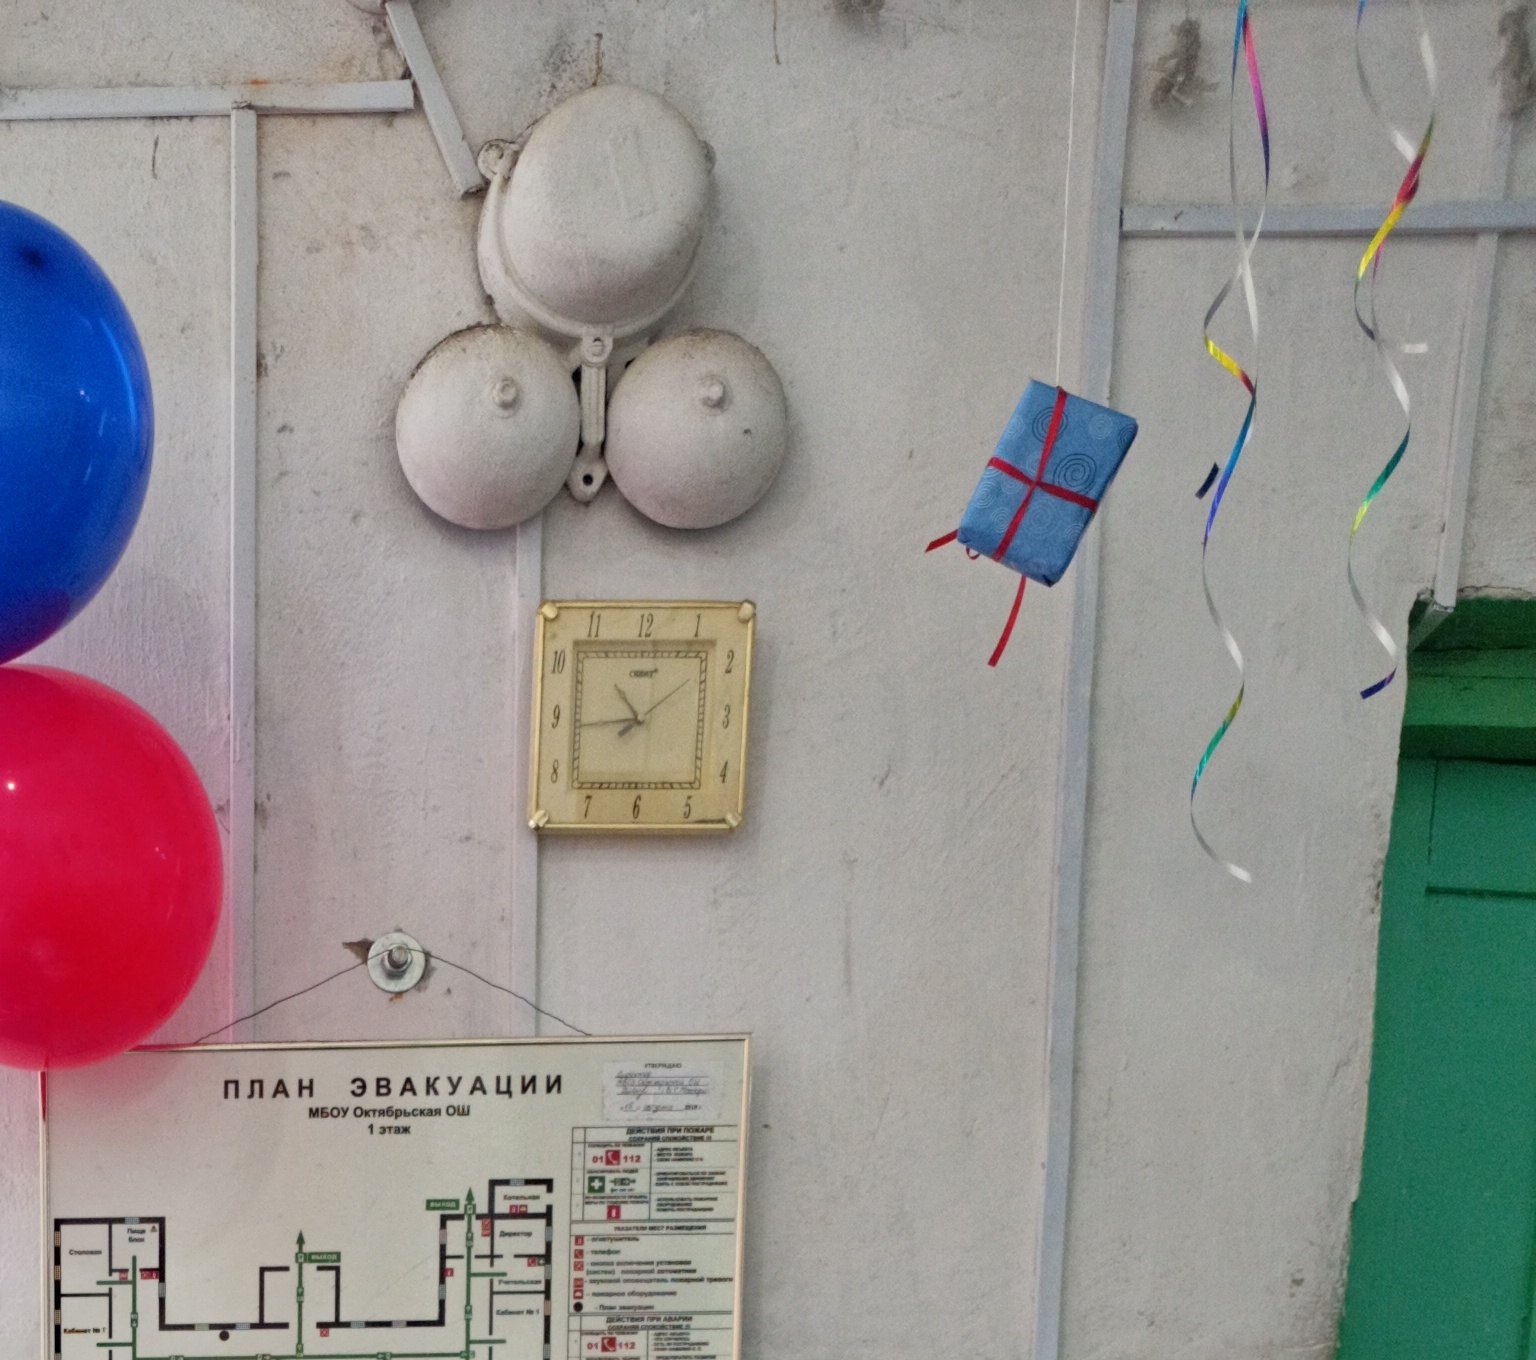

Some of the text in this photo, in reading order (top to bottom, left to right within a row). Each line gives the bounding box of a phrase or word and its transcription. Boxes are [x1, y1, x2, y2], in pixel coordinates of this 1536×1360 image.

[587, 610, 601, 638] 11
[638, 613, 654, 638] 12
[694, 613, 701, 638] 1
[551, 650, 565, 674] 10
[724, 649, 734, 674] 2
[551, 704, 560, 729] 9
[722, 704, 731, 729] 3
[550, 759, 559, 783] 8
[720, 760, 728, 783] 4
[584, 795, 592, 819] 7
[632, 795, 641, 819] 6
[683, 795, 692, 819] 5
[223, 1075, 563, 1100] ПЛАН ЭВАКУАЦИИ
[308, 1105, 471, 1121] МБОУ Октябрьская ОШ
[367, 1124, 412, 1136] 1 этаж
[592, 1155, 641, 1164] 01 112
